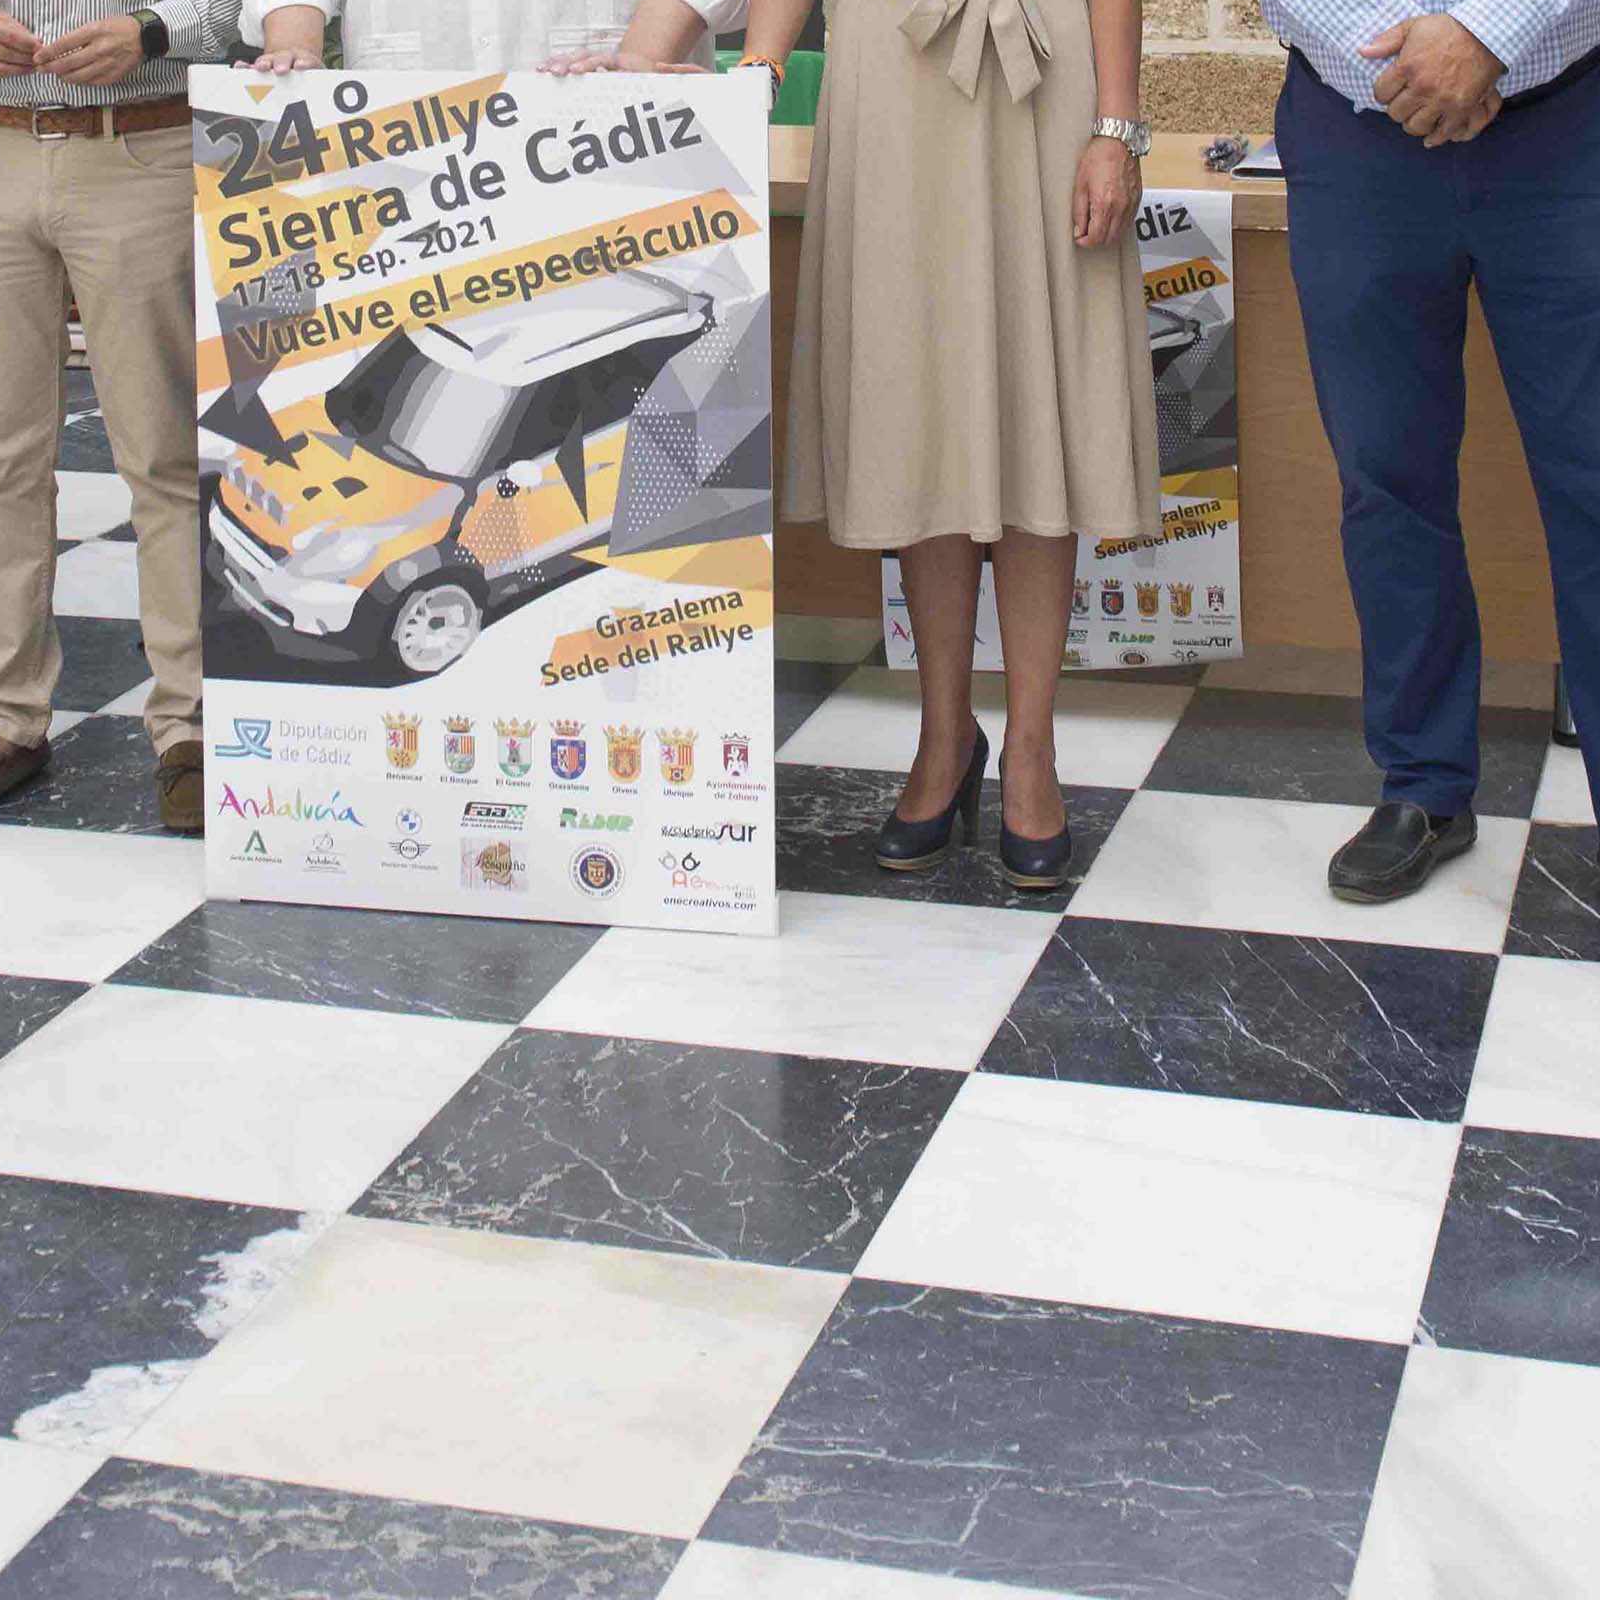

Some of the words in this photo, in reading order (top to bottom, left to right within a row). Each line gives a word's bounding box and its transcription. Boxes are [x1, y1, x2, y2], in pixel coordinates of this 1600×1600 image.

[338, 89, 519, 169] Rallye
[218, 186, 412, 269] Sierra
[429, 153, 507, 212] de
[525, 101, 703, 184] Cádiz
[233, 261, 325, 308] 17-18
[333, 247, 406, 281] Sep.
[418, 215, 497, 260] 2021
[236, 298, 395, 362] Vuelve
[409, 273, 450, 319] el
[463, 205, 740, 303] espectáculo
[1093, 541, 1139, 560] Sede
[1174, 518, 1228, 543] Rallye
[596, 590, 744, 640] Grazalema
[539, 654, 610, 687] Sede
[618, 638, 660, 669] del
[666, 623, 754, 657] Rallye
[279, 719, 368, 743] Diputación
[279, 747, 300, 763] de
[306, 745, 352, 766] Cádiz
[216, 781, 368, 828] Andalucía
